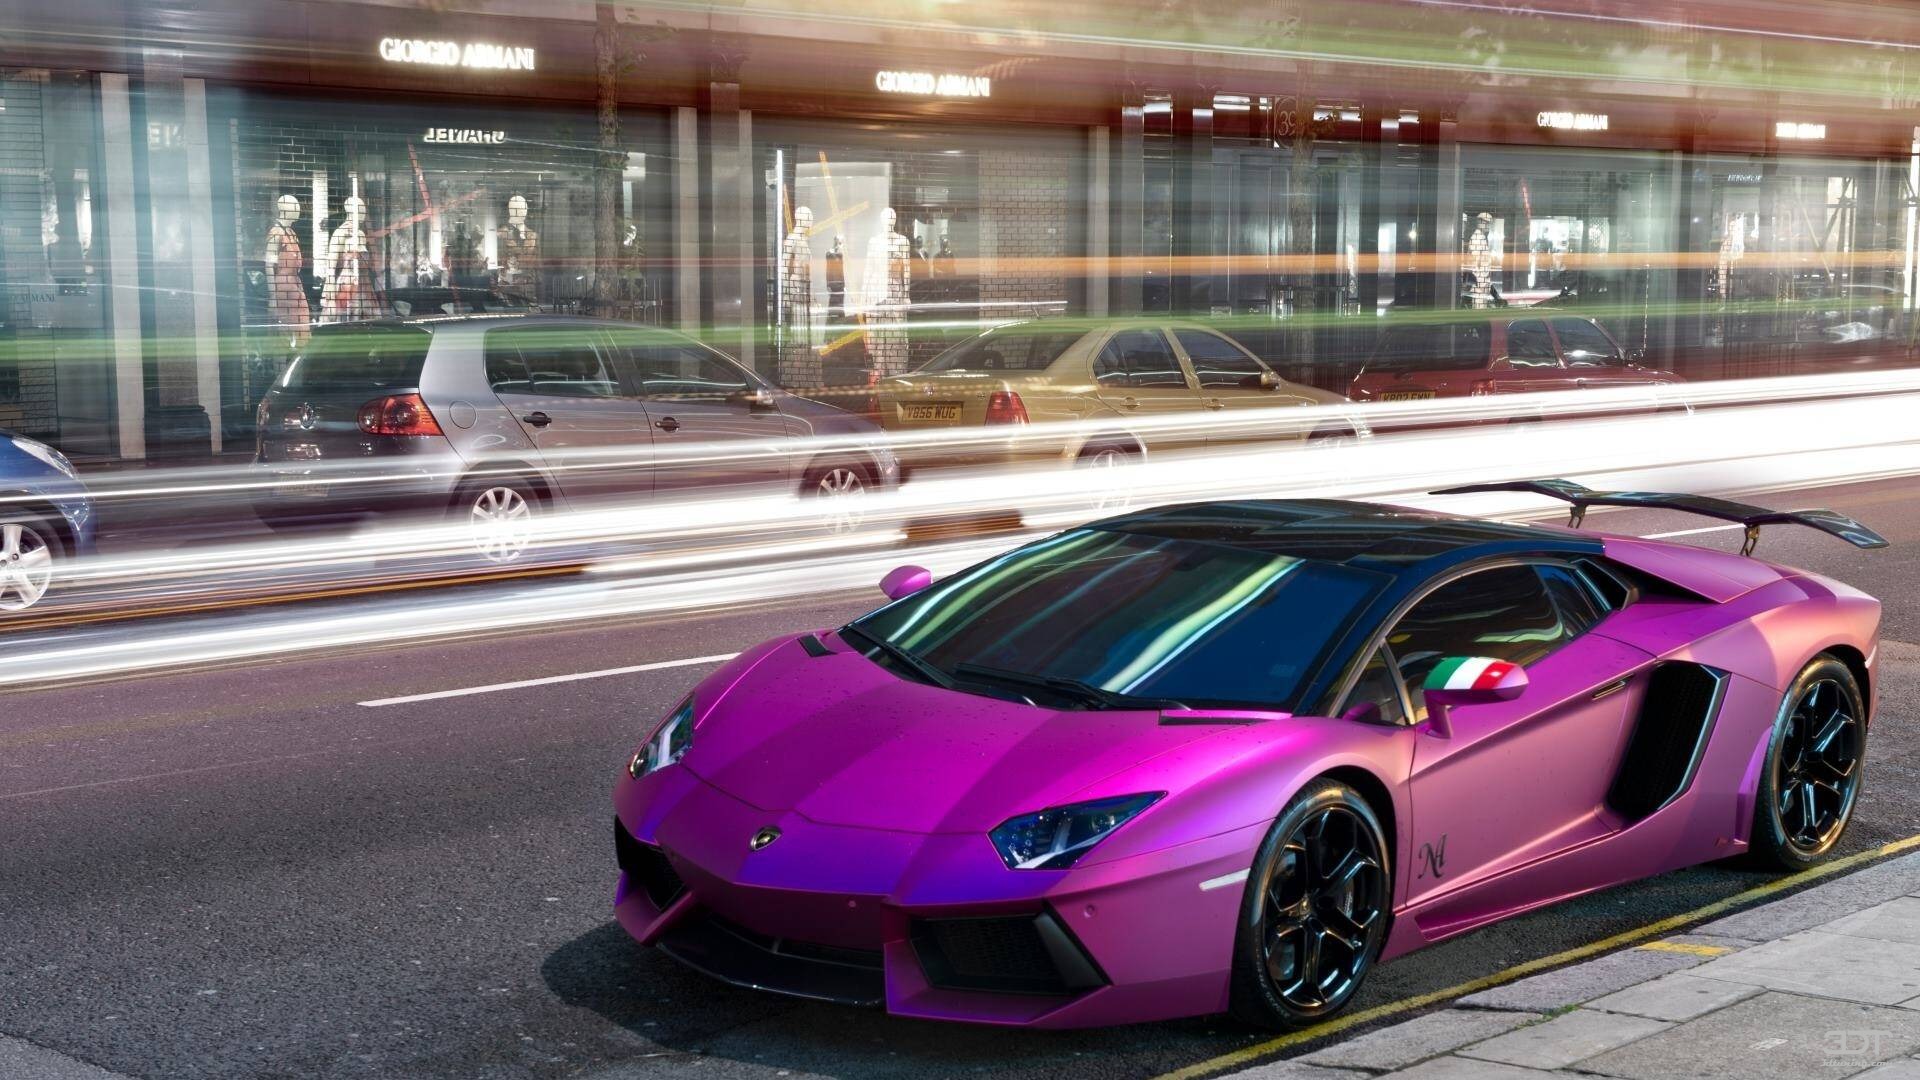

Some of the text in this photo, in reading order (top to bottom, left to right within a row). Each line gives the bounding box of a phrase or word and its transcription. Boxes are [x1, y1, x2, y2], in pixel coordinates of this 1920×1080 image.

[379, 37, 535, 70] GIORGIO ARMANI
[876, 71, 990, 96] GIORGIO ARMANI
